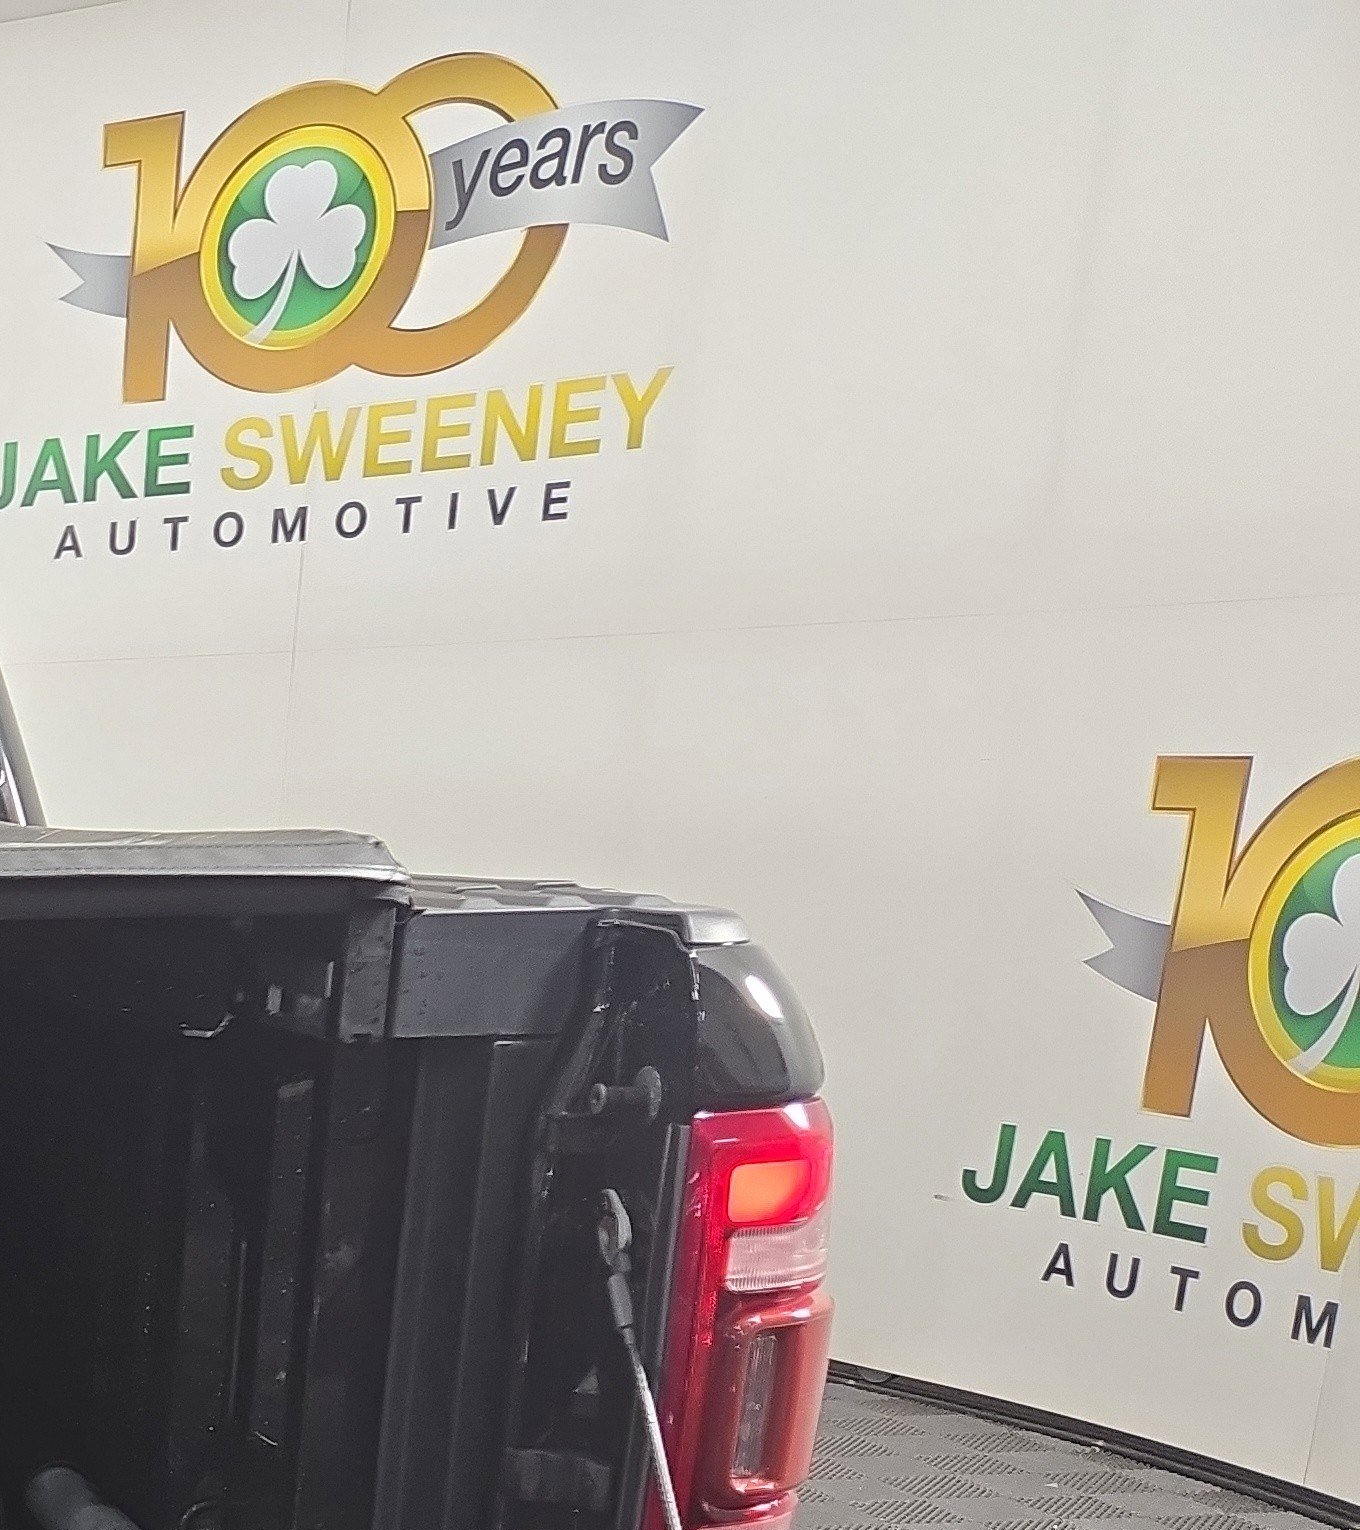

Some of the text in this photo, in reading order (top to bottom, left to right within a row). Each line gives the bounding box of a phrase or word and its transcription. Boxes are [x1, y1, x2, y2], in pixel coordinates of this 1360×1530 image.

[104, 52, 639, 403] 100 years
[221, 366, 676, 493] SWEENEY
[54, 481, 573, 561] AUTOMOTIVE
[961, 1123, 1219, 1245] JAKE
[1041, 1243, 1339, 1349] AUTOM
